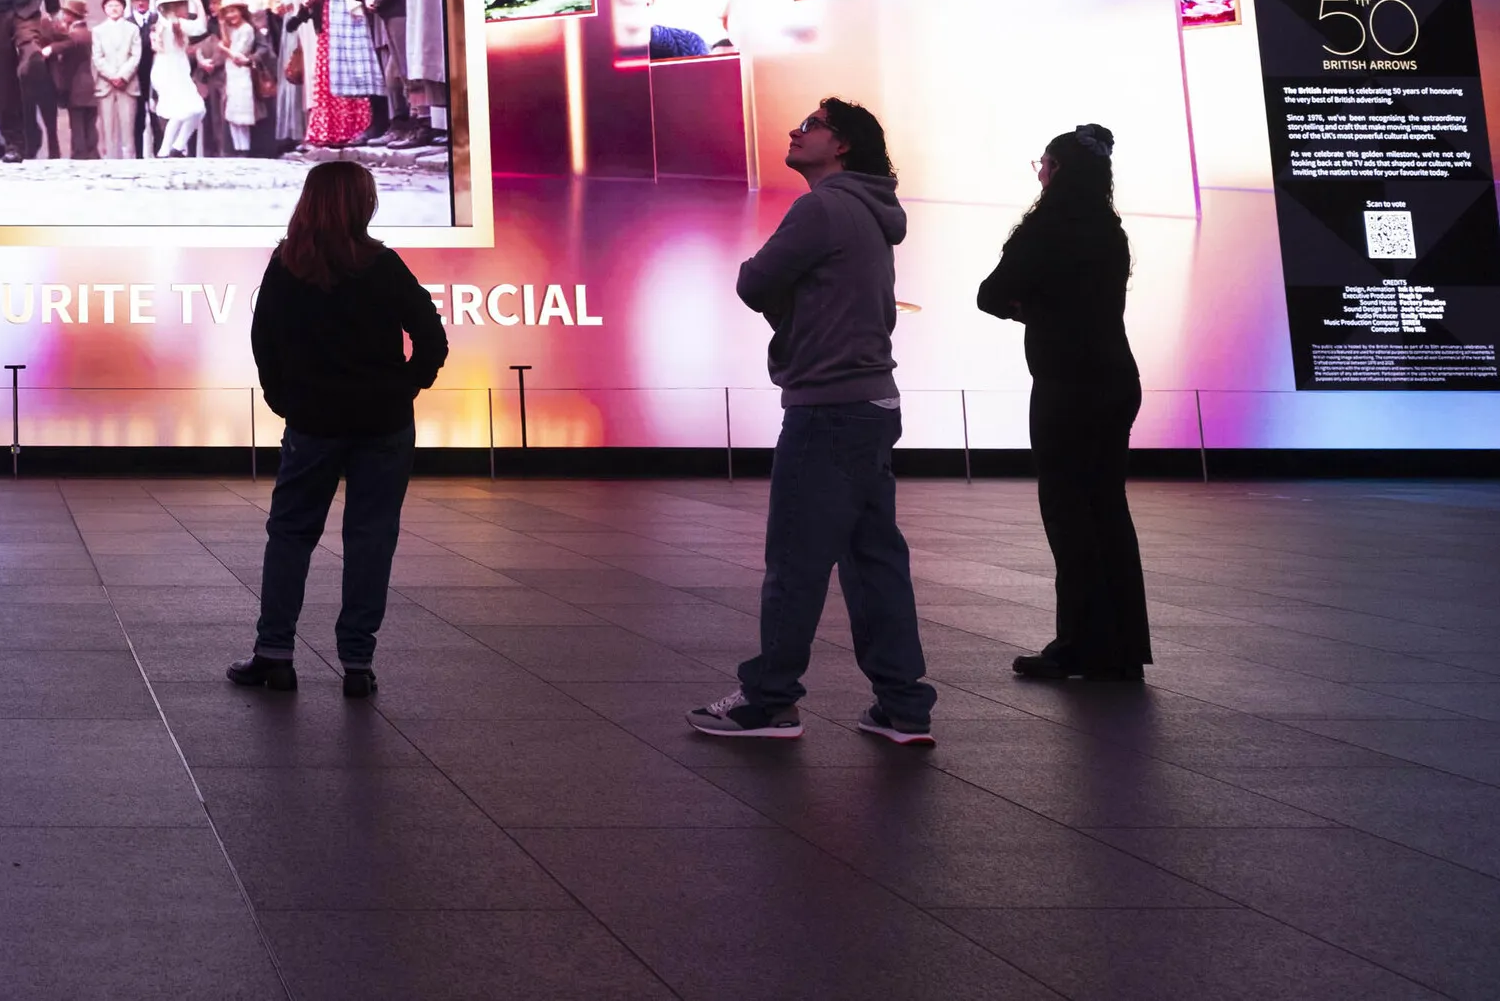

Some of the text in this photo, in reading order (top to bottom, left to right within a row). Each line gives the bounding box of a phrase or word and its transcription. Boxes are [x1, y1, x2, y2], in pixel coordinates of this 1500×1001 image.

[1323, 60, 1418, 70] BRITISH ARROWS
[1356, 88, 1392, 96] celebrating
[1429, 88, 1463, 96] honouring
[1368, 115, 1406, 124] recognising
[1422, 115, 1466, 124] extraordinary
[1386, 124, 1411, 132] moving
[1431, 124, 1468, 132] advertising
[1354, 133, 1384, 142] powerful
[1361, 151, 1384, 160] golden
[1456, 151, 1471, 160] only
[1292, 160, 1317, 169] looking
[1391, 160, 1416, 169] shaped
[1292, 169, 1318, 178] inviting
[171, 283, 238, 325] TV
